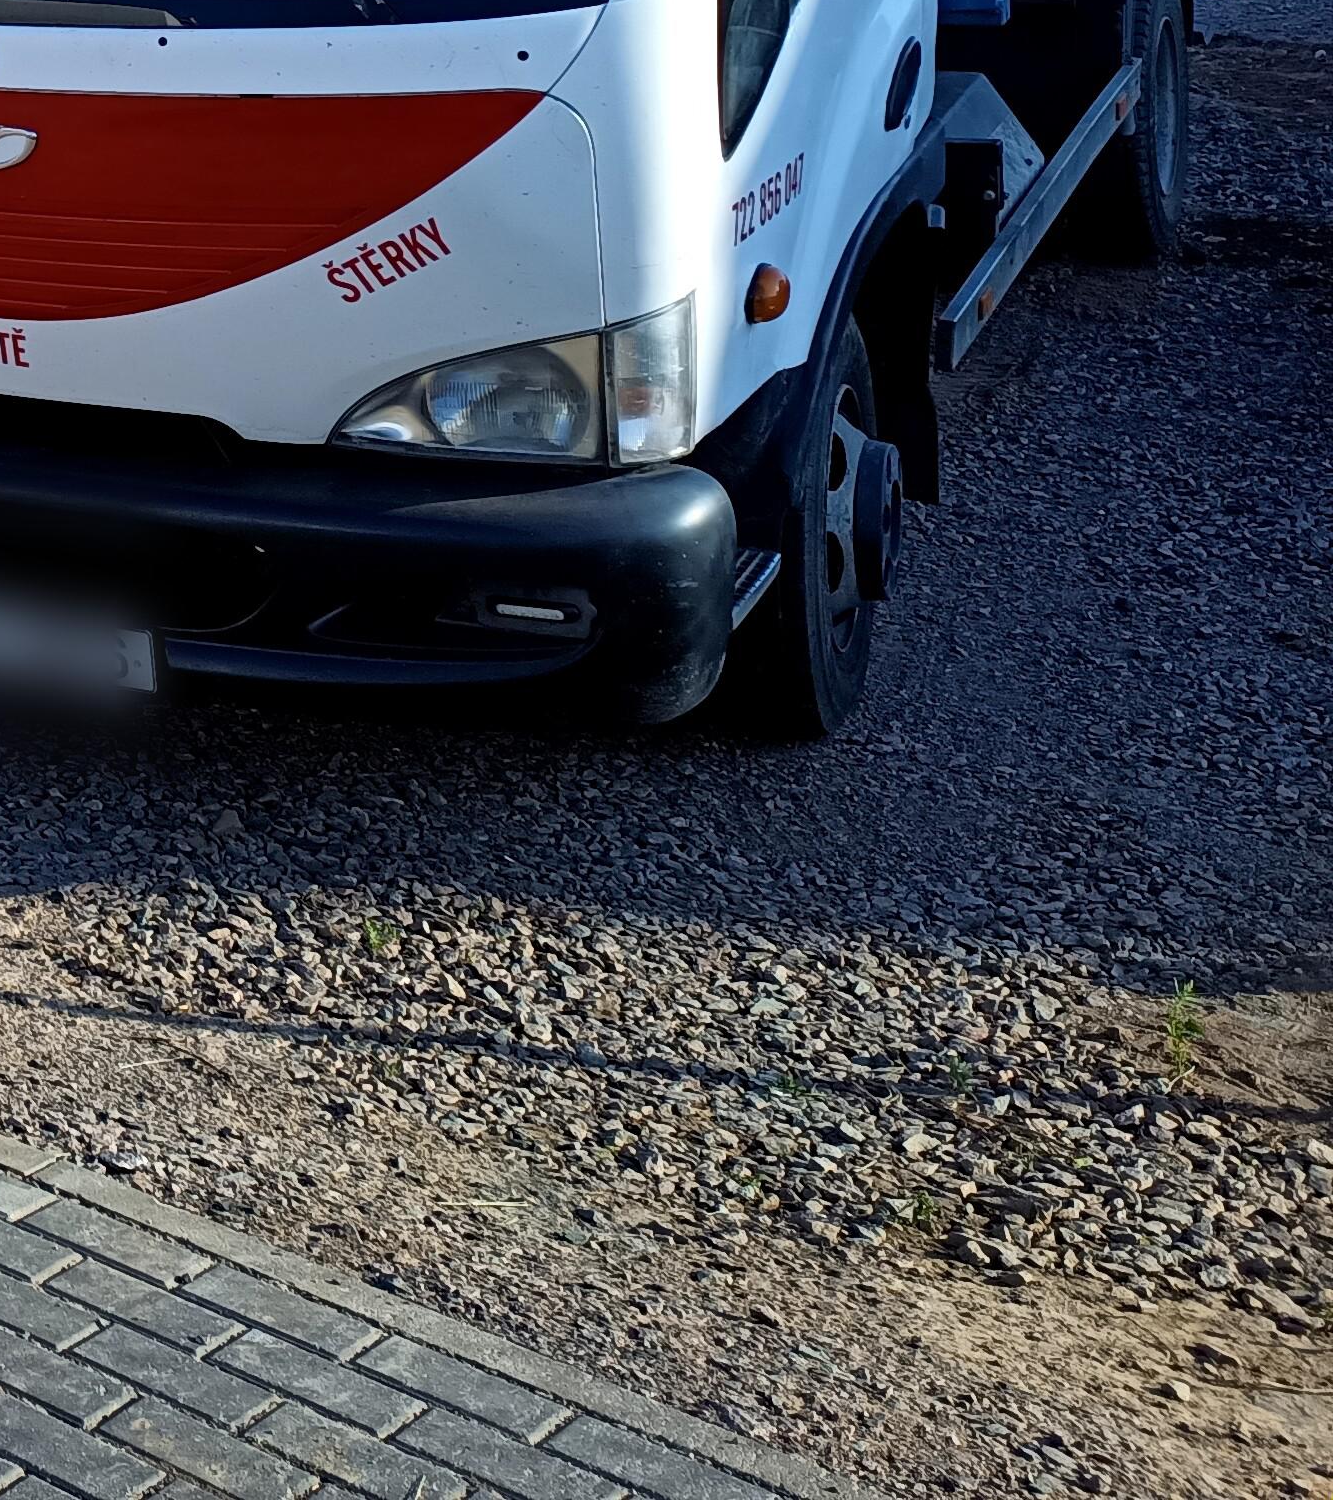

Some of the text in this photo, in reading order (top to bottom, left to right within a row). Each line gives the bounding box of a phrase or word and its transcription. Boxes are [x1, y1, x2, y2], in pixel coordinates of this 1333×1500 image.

[732, 152, 804, 247] 722 856 047
[321, 217, 451, 303] ŠTĚRKY
